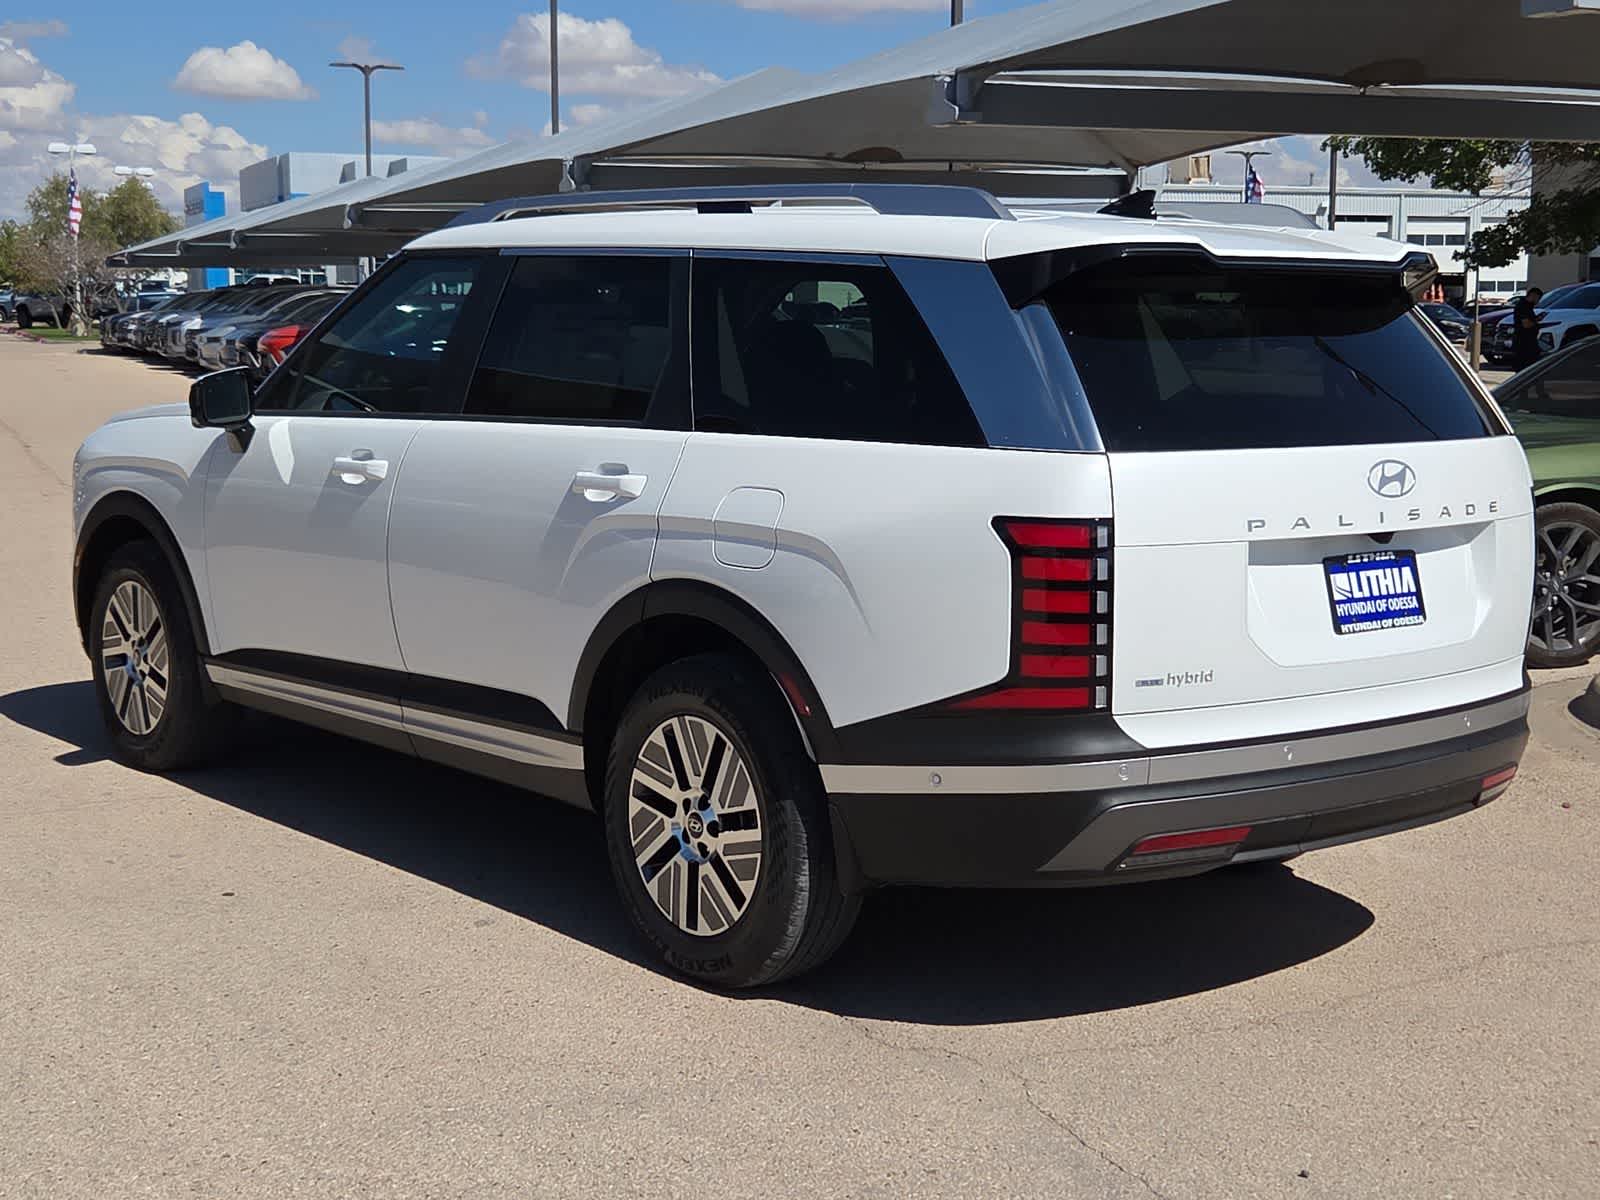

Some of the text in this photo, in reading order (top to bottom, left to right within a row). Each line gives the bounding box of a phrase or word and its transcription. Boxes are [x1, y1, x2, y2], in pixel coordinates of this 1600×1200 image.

[1247, 500, 1499, 533] PALISADE
[1348, 566, 1416, 598] LITHIA
[1336, 595, 1418, 616] HYUNDAI OF ODESSA
[1340, 615, 1425, 633] HYUNDAI OF ODESSA
[1166, 669, 1214, 688] hybrid
